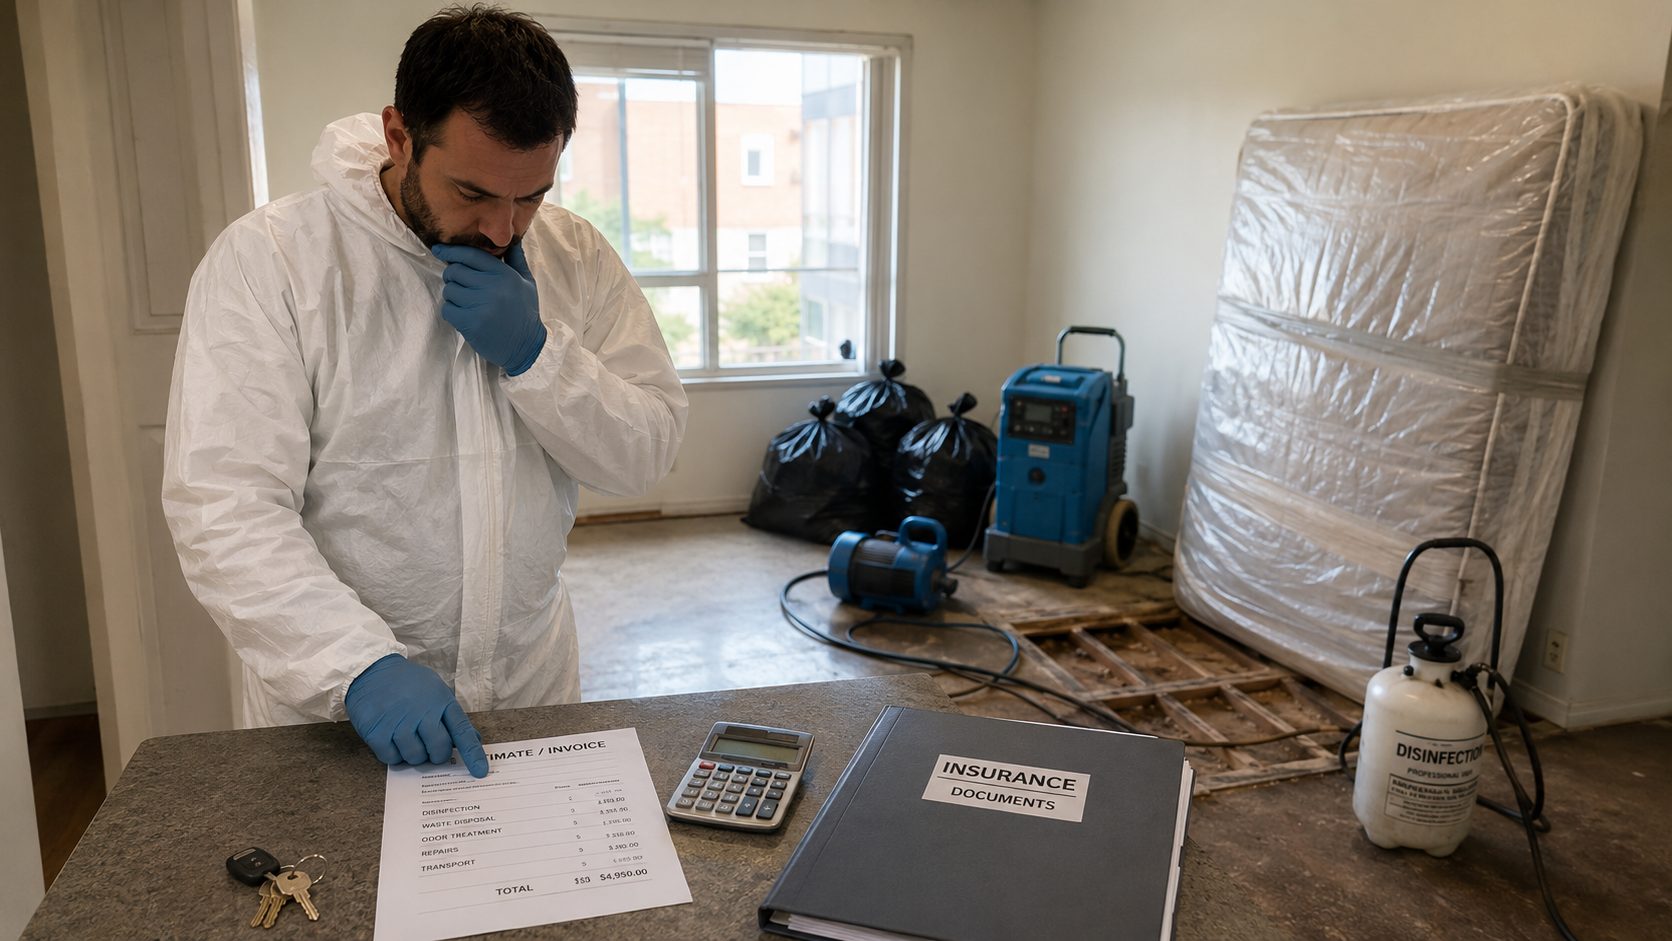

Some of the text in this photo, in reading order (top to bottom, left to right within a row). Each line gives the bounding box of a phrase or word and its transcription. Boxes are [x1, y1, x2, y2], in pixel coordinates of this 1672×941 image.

[548, 740, 606, 754] INVOICE
[942, 761, 1077, 791] INSURANCE
[951, 786, 1055, 810] DOCUMENTS
[422, 805, 480, 816] DISINFECTION
[422, 816, 496, 829] WASTE DISPOSAL
[421, 828, 502, 843] ODOR TREATMENT
[421, 847, 459, 857] REPAIRS
[421, 859, 476, 872] TRANSPORT
[496, 884, 534, 896] TOTAL
